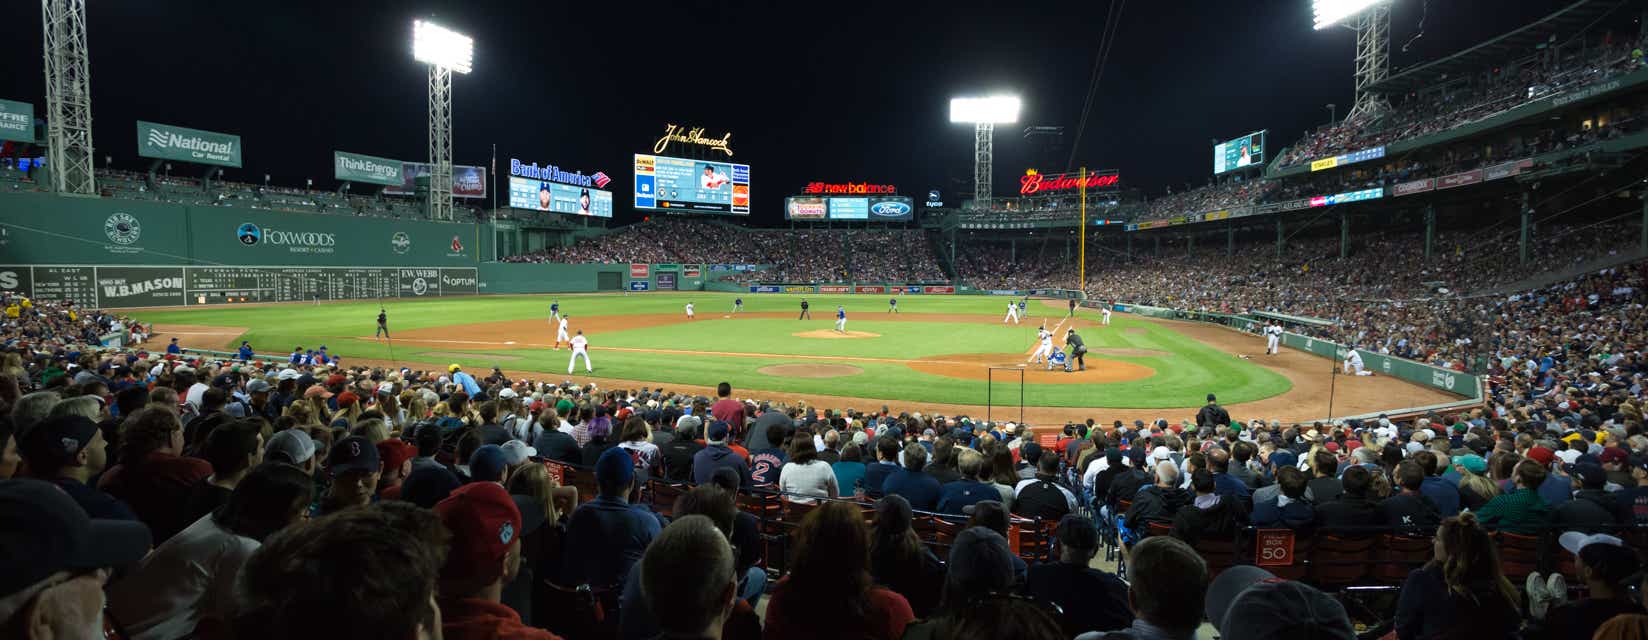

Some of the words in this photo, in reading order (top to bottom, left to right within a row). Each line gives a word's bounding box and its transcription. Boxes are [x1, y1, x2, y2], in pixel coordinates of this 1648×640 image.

[168, 133, 232, 153] National
[654, 123, 688, 154] John
[688, 127, 733, 156] Hancock
[206, 153, 231, 161] Rental
[511, 158, 540, 179] Bank
[541, 164, 552, 180] of
[553, 166, 592, 187] America
[825, 184, 847, 193] new
[848, 181, 896, 193] balance
[1020, 171, 1119, 195] Budweiser
[878, 205, 903, 214] Ford
[263, 228, 335, 246] FOXWOODS
[416, 269, 438, 279] WEBB
[450, 278, 475, 287] OPTUM
[751, 462, 770, 483] 2
[1262, 547, 1287, 560] 50
